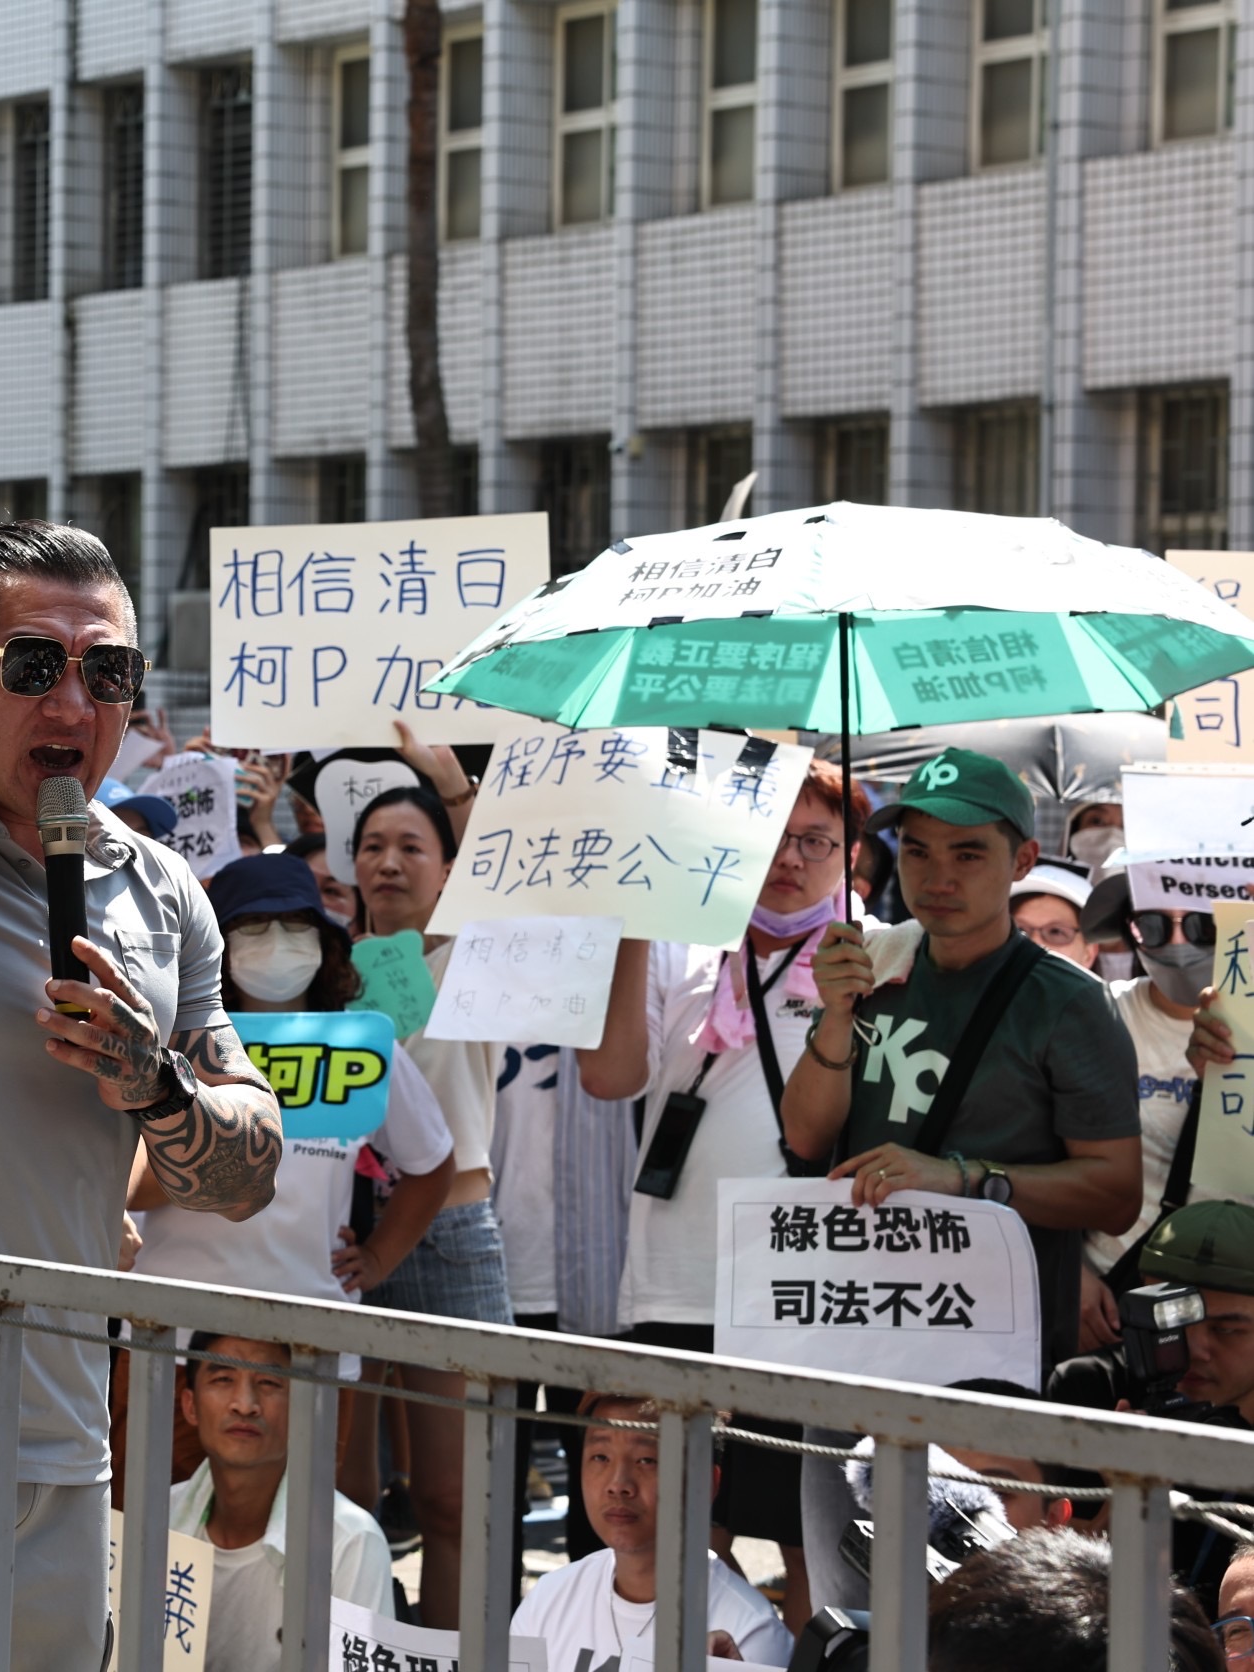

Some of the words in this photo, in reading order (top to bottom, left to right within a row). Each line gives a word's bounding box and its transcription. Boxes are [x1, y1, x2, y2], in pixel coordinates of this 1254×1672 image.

[219, 539, 506, 620] 相信清白
[627, 546, 783, 584] 相信清白
[224, 642, 494, 712] 柯P加
[166, 788, 215, 819] 恐怖
[471, 827, 744, 907] 司法要公平
[462, 931, 597, 966] 相信清白
[450, 988, 588, 1017] 柯P加油
[247, 1042, 386, 1109] 柯P
[293, 1143, 347, 1161] Promise
[770, 1205, 972, 1254] 綠色恐怖
[771, 1279, 977, 1330] 司法不公
[342, 1631, 459, 1672] 綠色
